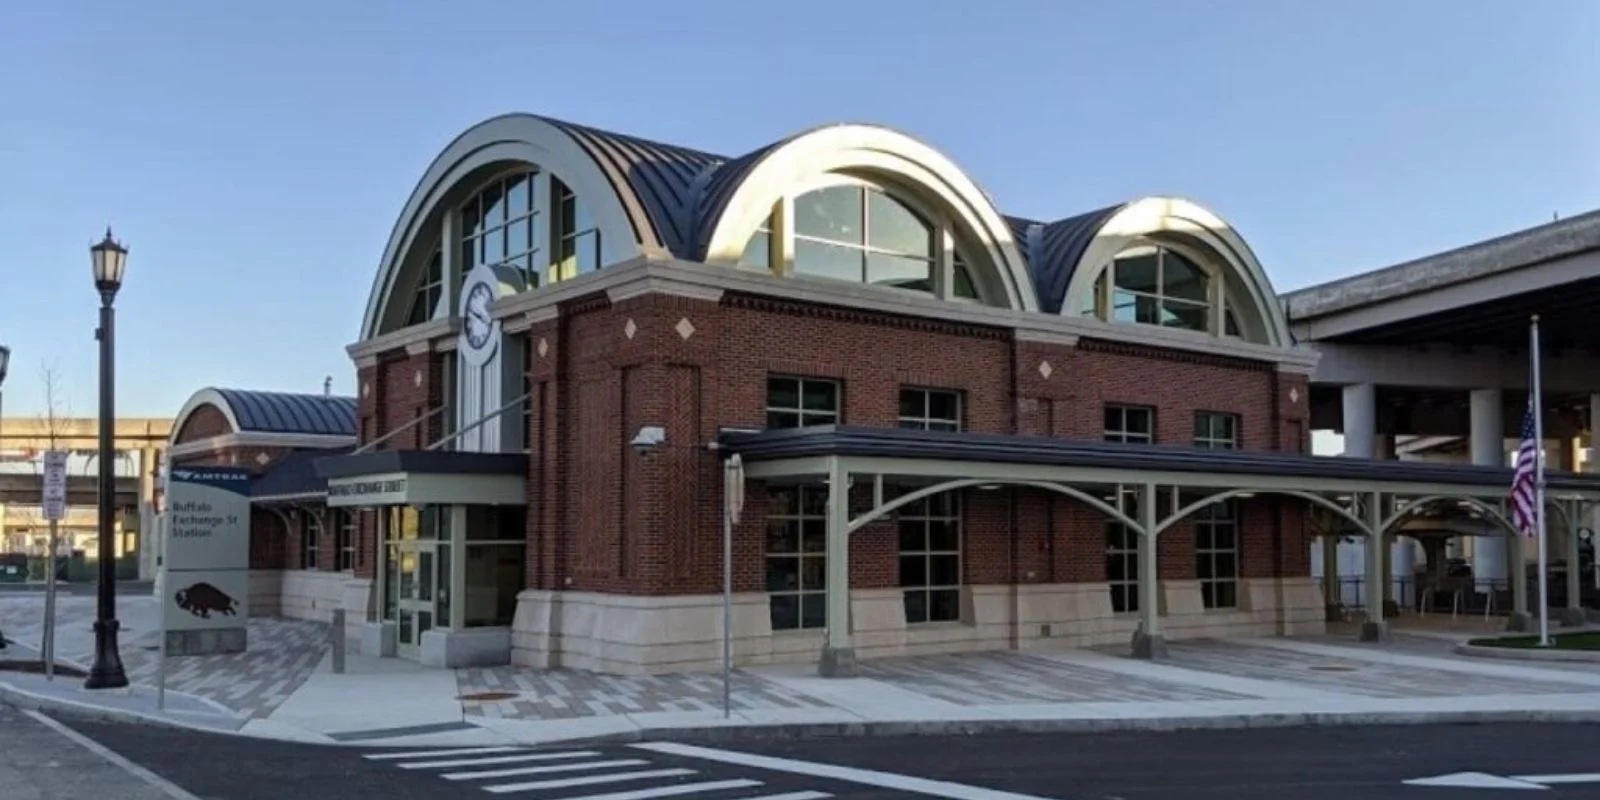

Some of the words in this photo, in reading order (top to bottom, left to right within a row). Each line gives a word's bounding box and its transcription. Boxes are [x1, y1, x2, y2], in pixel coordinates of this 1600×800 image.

[193, 472, 248, 481] AMTRAK
[172, 501, 212, 512] Buffalo
[172, 514, 224, 528] Exchange
[227, 514, 238, 525] St
[172, 527, 212, 538] Station
